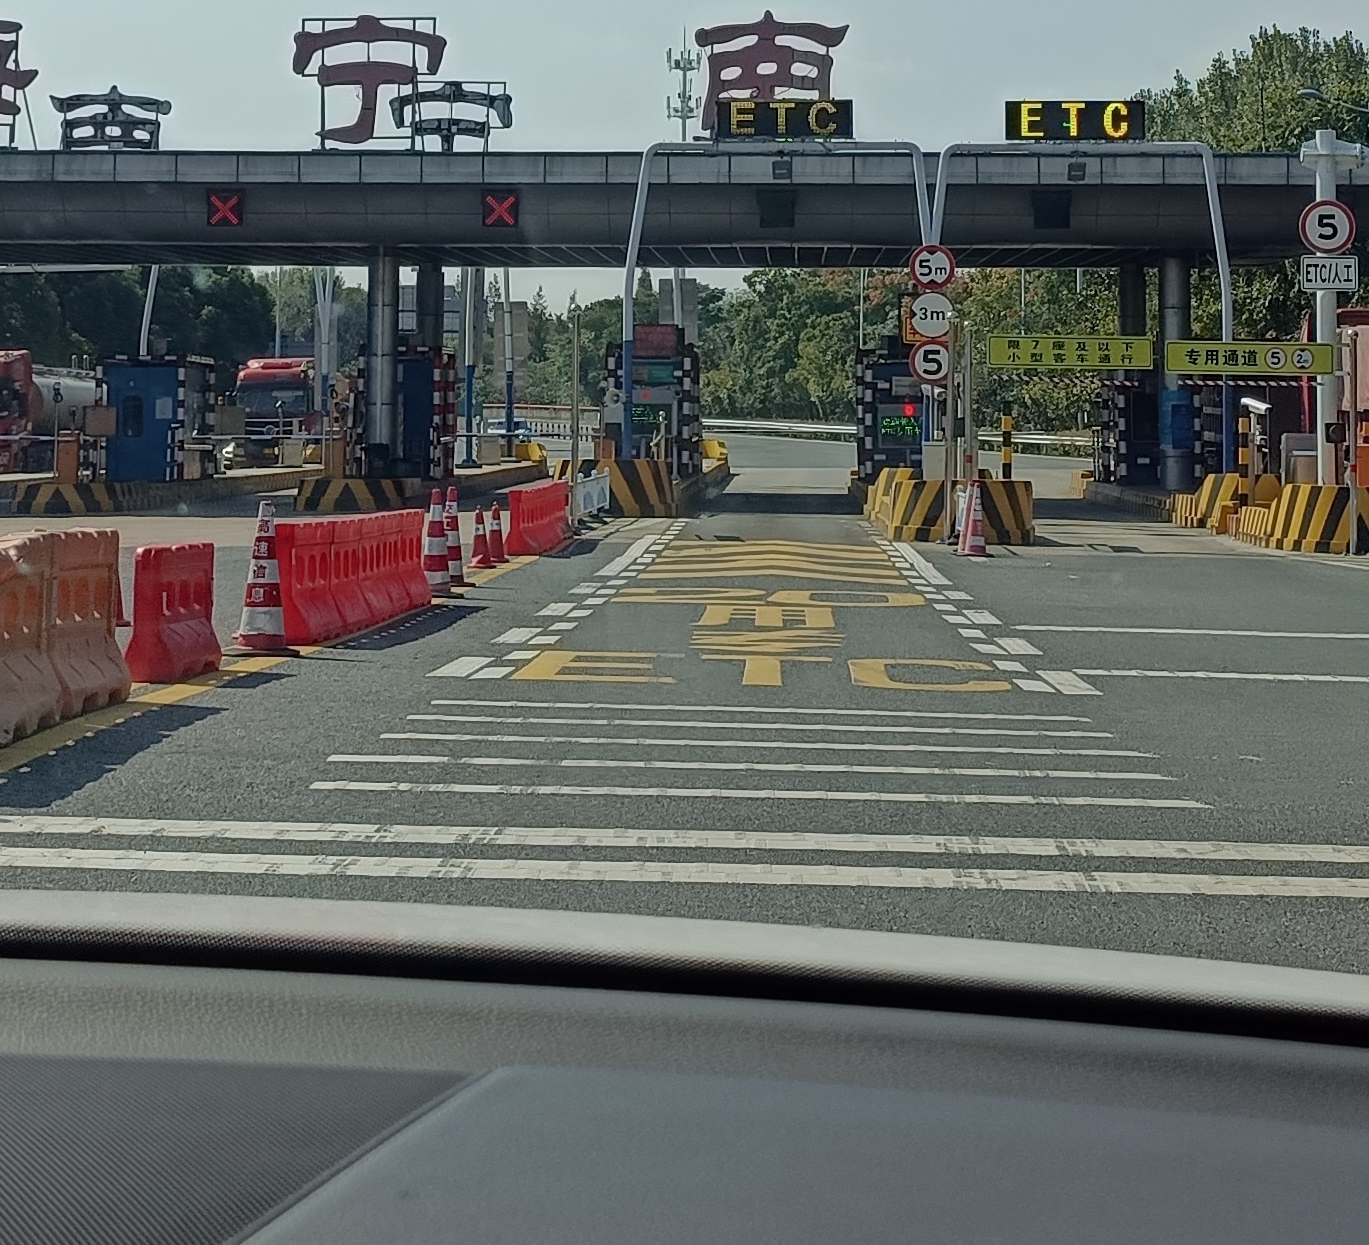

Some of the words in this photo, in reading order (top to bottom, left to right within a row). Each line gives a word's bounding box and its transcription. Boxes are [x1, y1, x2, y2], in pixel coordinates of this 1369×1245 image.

[730, 100, 837, 135] ETC
[1020, 101, 1129, 138] ETC
[1317, 213, 1338, 241] 5
[918, 258, 947, 277] 5m
[1305, 262, 1353, 284] ETC/人工
[919, 307, 946, 321] 3m
[922, 349, 942, 375] 5
[1185, 349, 1259, 366] 专用通道
[1270, 351, 1281, 366] 5
[610, 587, 928, 608] 20
[510, 649, 1011, 692] ETC
